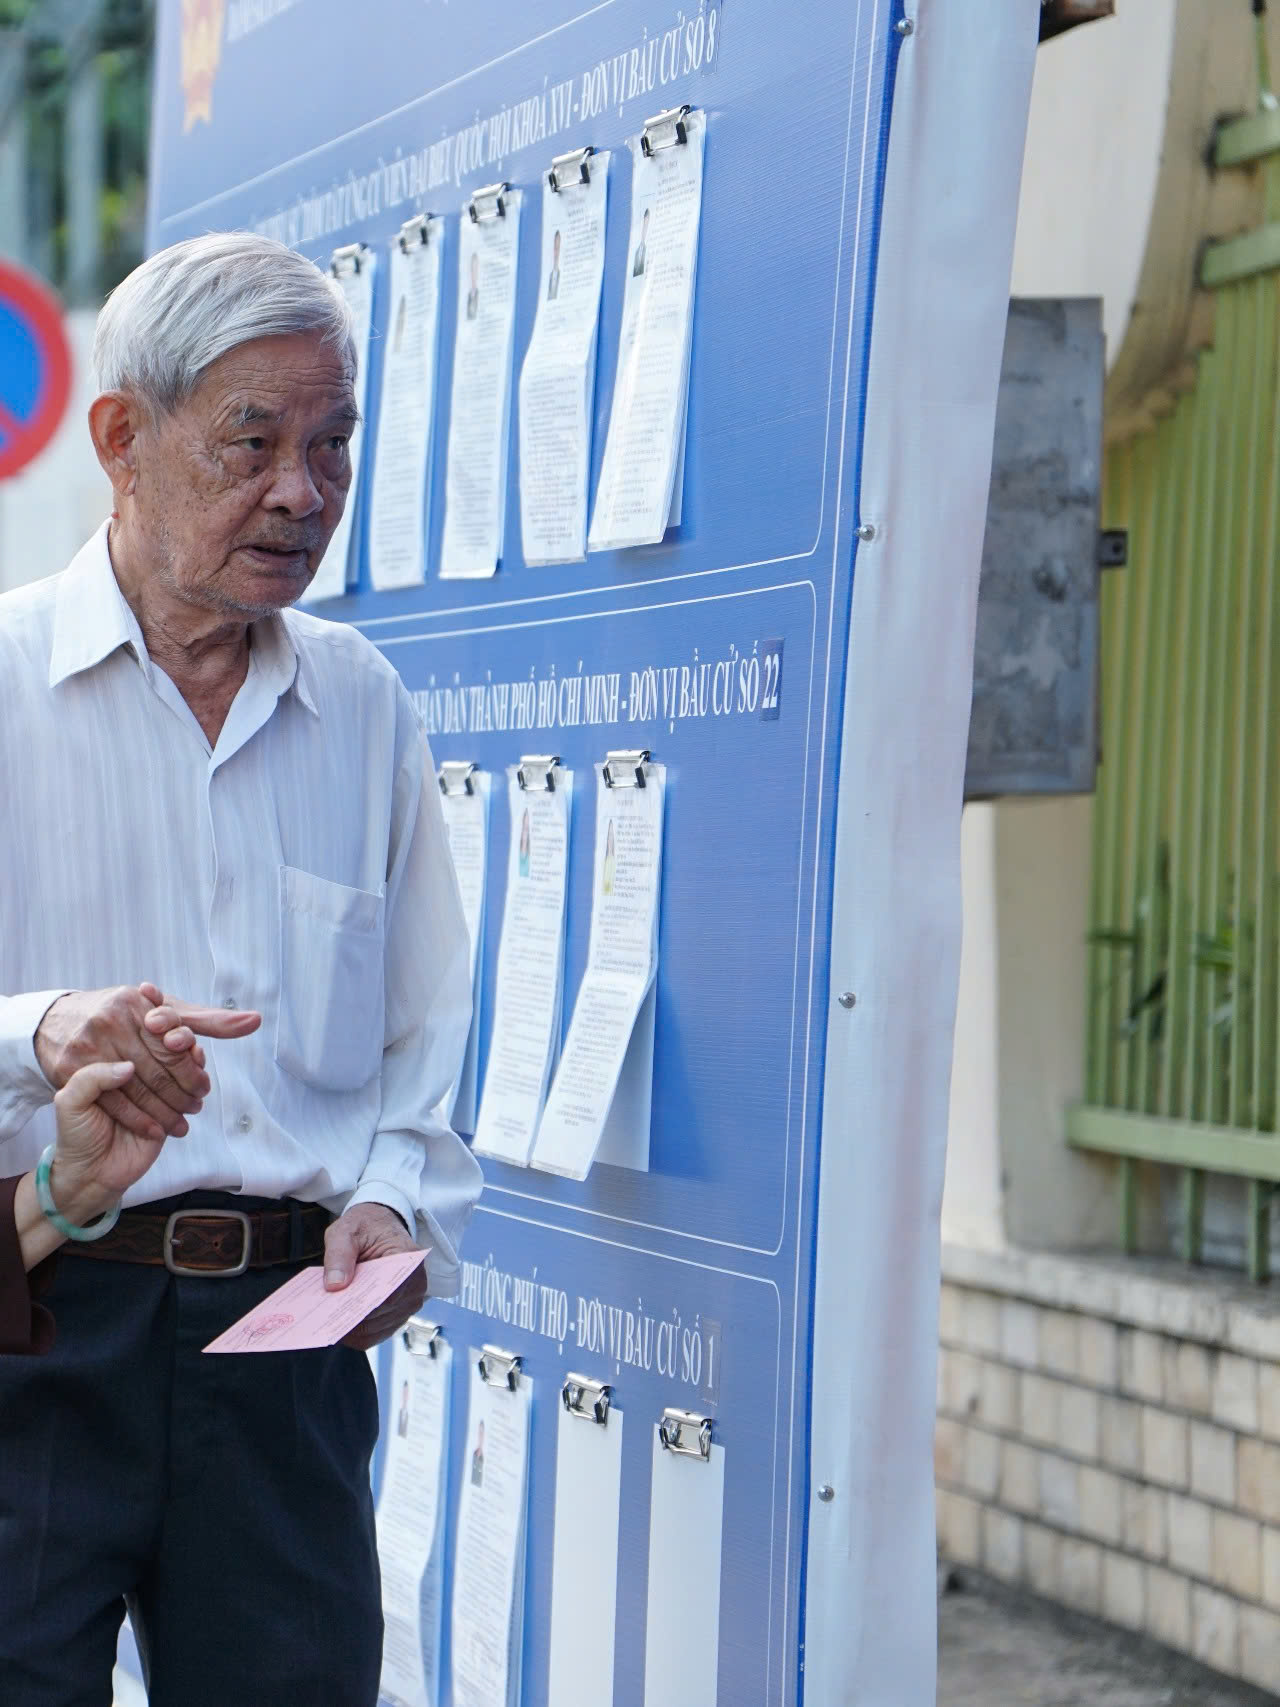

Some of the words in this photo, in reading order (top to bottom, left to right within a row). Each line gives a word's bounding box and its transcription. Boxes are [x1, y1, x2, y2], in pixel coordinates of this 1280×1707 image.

[454, 109, 489, 188] QUỐC
[488, 104, 511, 172] HỘI
[511, 76, 548, 153] KHOÁ
[547, 79, 574, 136] XVI
[579, 60, 609, 123] ĐƠN
[612, 53, 626, 119] VỊ
[626, 27, 661, 98] BẦU
[660, 10, 687, 86] CỬ
[682, 0, 705, 75] SỐ
[706, 8, 717, 64] 8
[443, 671, 467, 734] DÂN
[468, 669, 510, 732] THÀNH
[509, 664, 537, 730] PHỐ
[537, 663, 558, 729] HỒ
[558, 659, 583, 727] CHÍ
[583, 673, 621, 725] MINH
[628, 666, 661, 722] ĐƠN
[662, 667, 679, 734] VỊ
[678, 647, 712, 717] BẦU
[712, 643, 739, 716] CỬ
[737, 639, 761, 713] SỐ
[761, 653, 780, 709] 22
[460, 1253, 513, 1324] PHƯỜNG
[512, 1266, 540, 1333] PHÚ
[540, 1284, 569, 1356] THỌ
[576, 1296, 608, 1357] ĐƠN
[608, 1306, 624, 1376] VỊ
[623, 1297, 656, 1371] BẦU
[656, 1307, 682, 1379] CỬ
[681, 1314, 703, 1386] SỐ
[707, 1335, 714, 1389] 1
